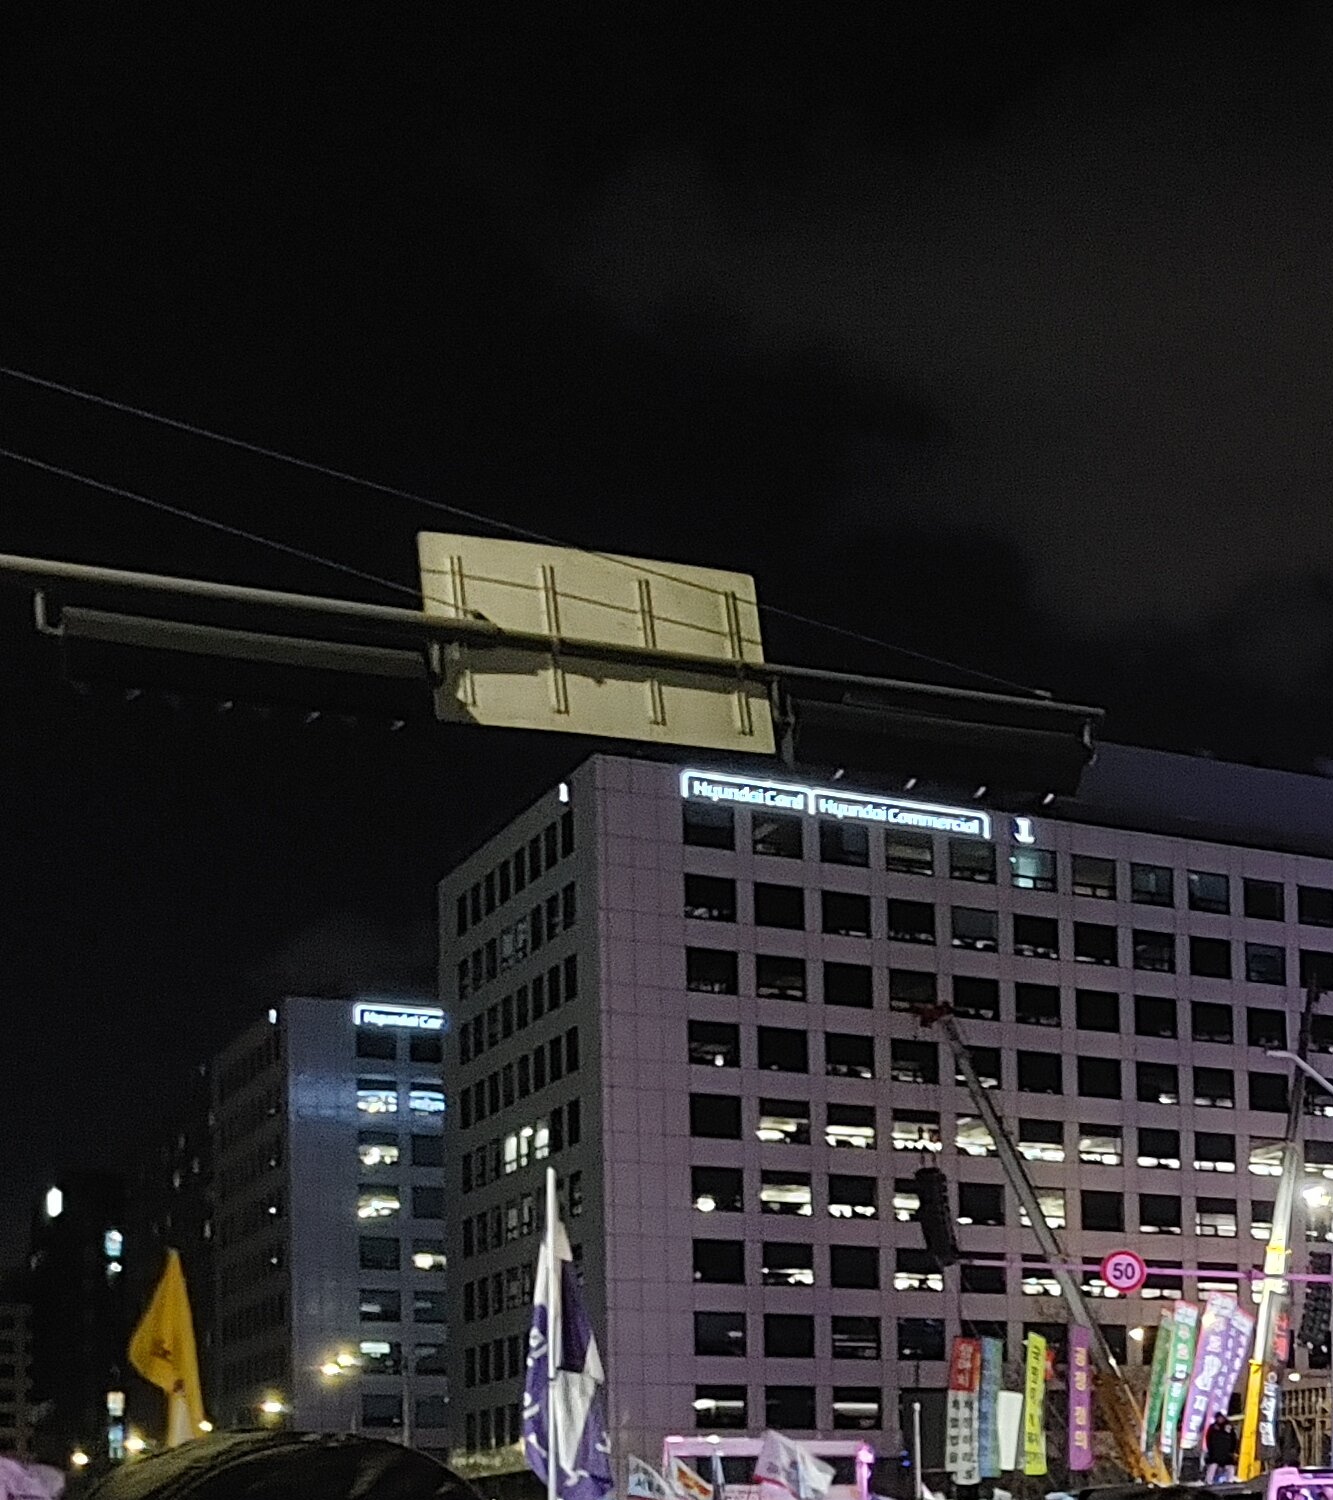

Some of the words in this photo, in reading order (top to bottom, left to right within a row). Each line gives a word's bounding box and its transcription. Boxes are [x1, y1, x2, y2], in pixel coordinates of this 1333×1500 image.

[693, 780, 763, 803] Hyundai
[765, 789, 804, 810] Card
[820, 798, 887, 821] Hyundai
[888, 808, 980, 834] Commercial
[1112, 1260, 1136, 1282] 50
